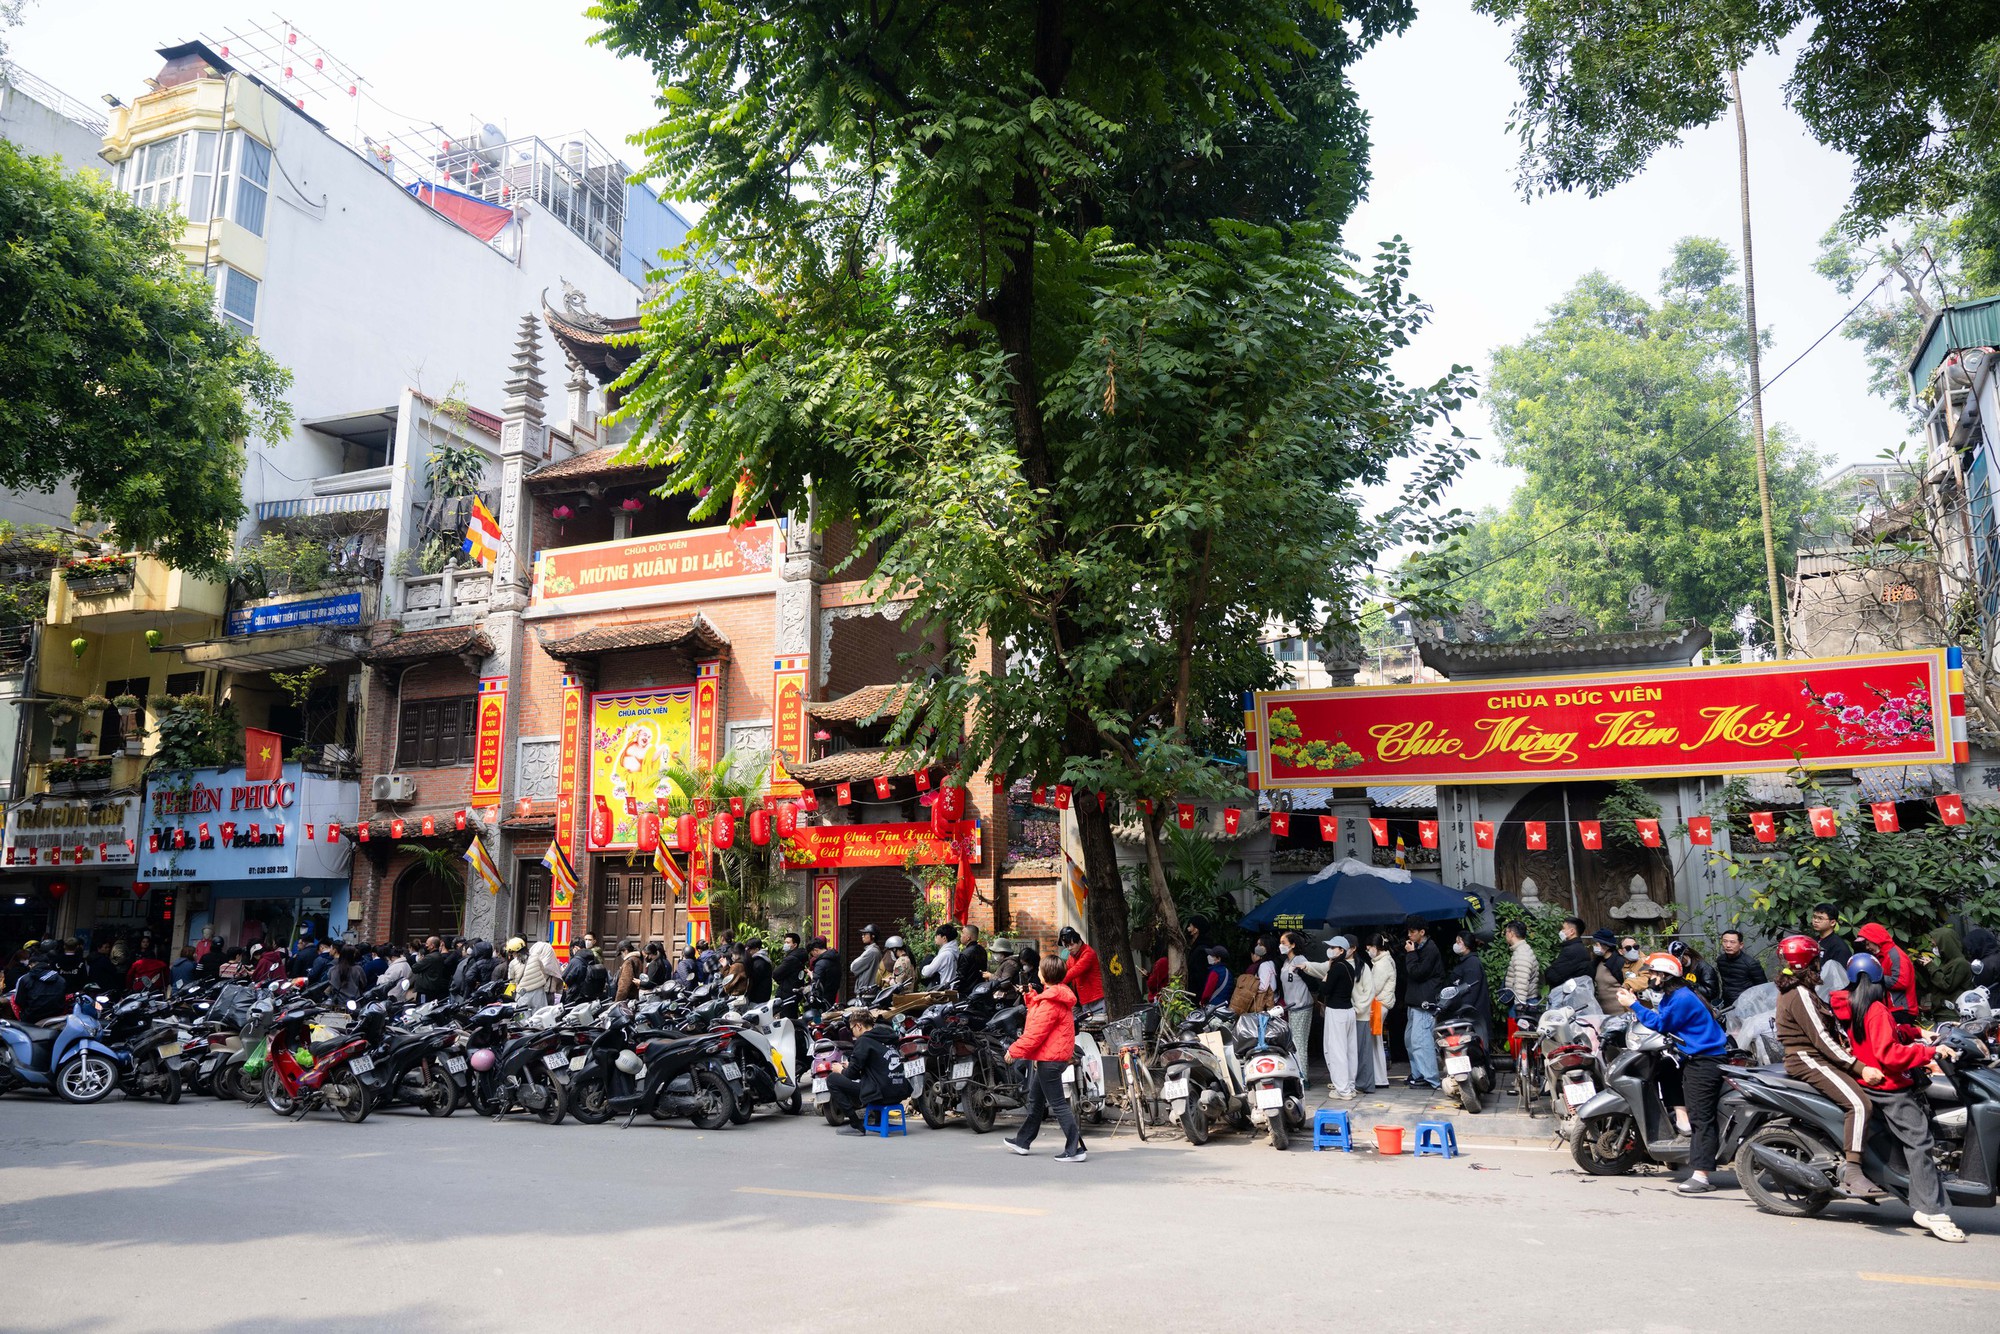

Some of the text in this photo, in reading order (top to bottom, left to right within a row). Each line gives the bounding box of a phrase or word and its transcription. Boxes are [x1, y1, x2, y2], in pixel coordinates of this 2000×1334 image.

[624, 540, 688, 556] CHÙA ĐỨC VIÊN
[579, 549, 734, 586] MỪNG XUÂN DI LẶC
[1487, 686, 1662, 710] CHÙA ĐỨC VIÊN
[618, 706, 668, 717] CHÙA ĐỨC VIÊN
[782, 710, 797, 721] QUỐC
[783, 722, 796, 730] THÁI
[1368, 703, 1805, 763] Chúc Mừng Năm Mới
[152, 779, 296, 815] THIÊN PHÚC
[810, 832, 840, 845] Cung
[844, 830, 872, 842] Chúc
[876, 830, 900, 842] Tân
[820, 846, 840, 858] Cát
[844, 845, 881, 858] Tường
[1109, 953, 1123, 976] 6
[1288, 973, 1293, 982] B
